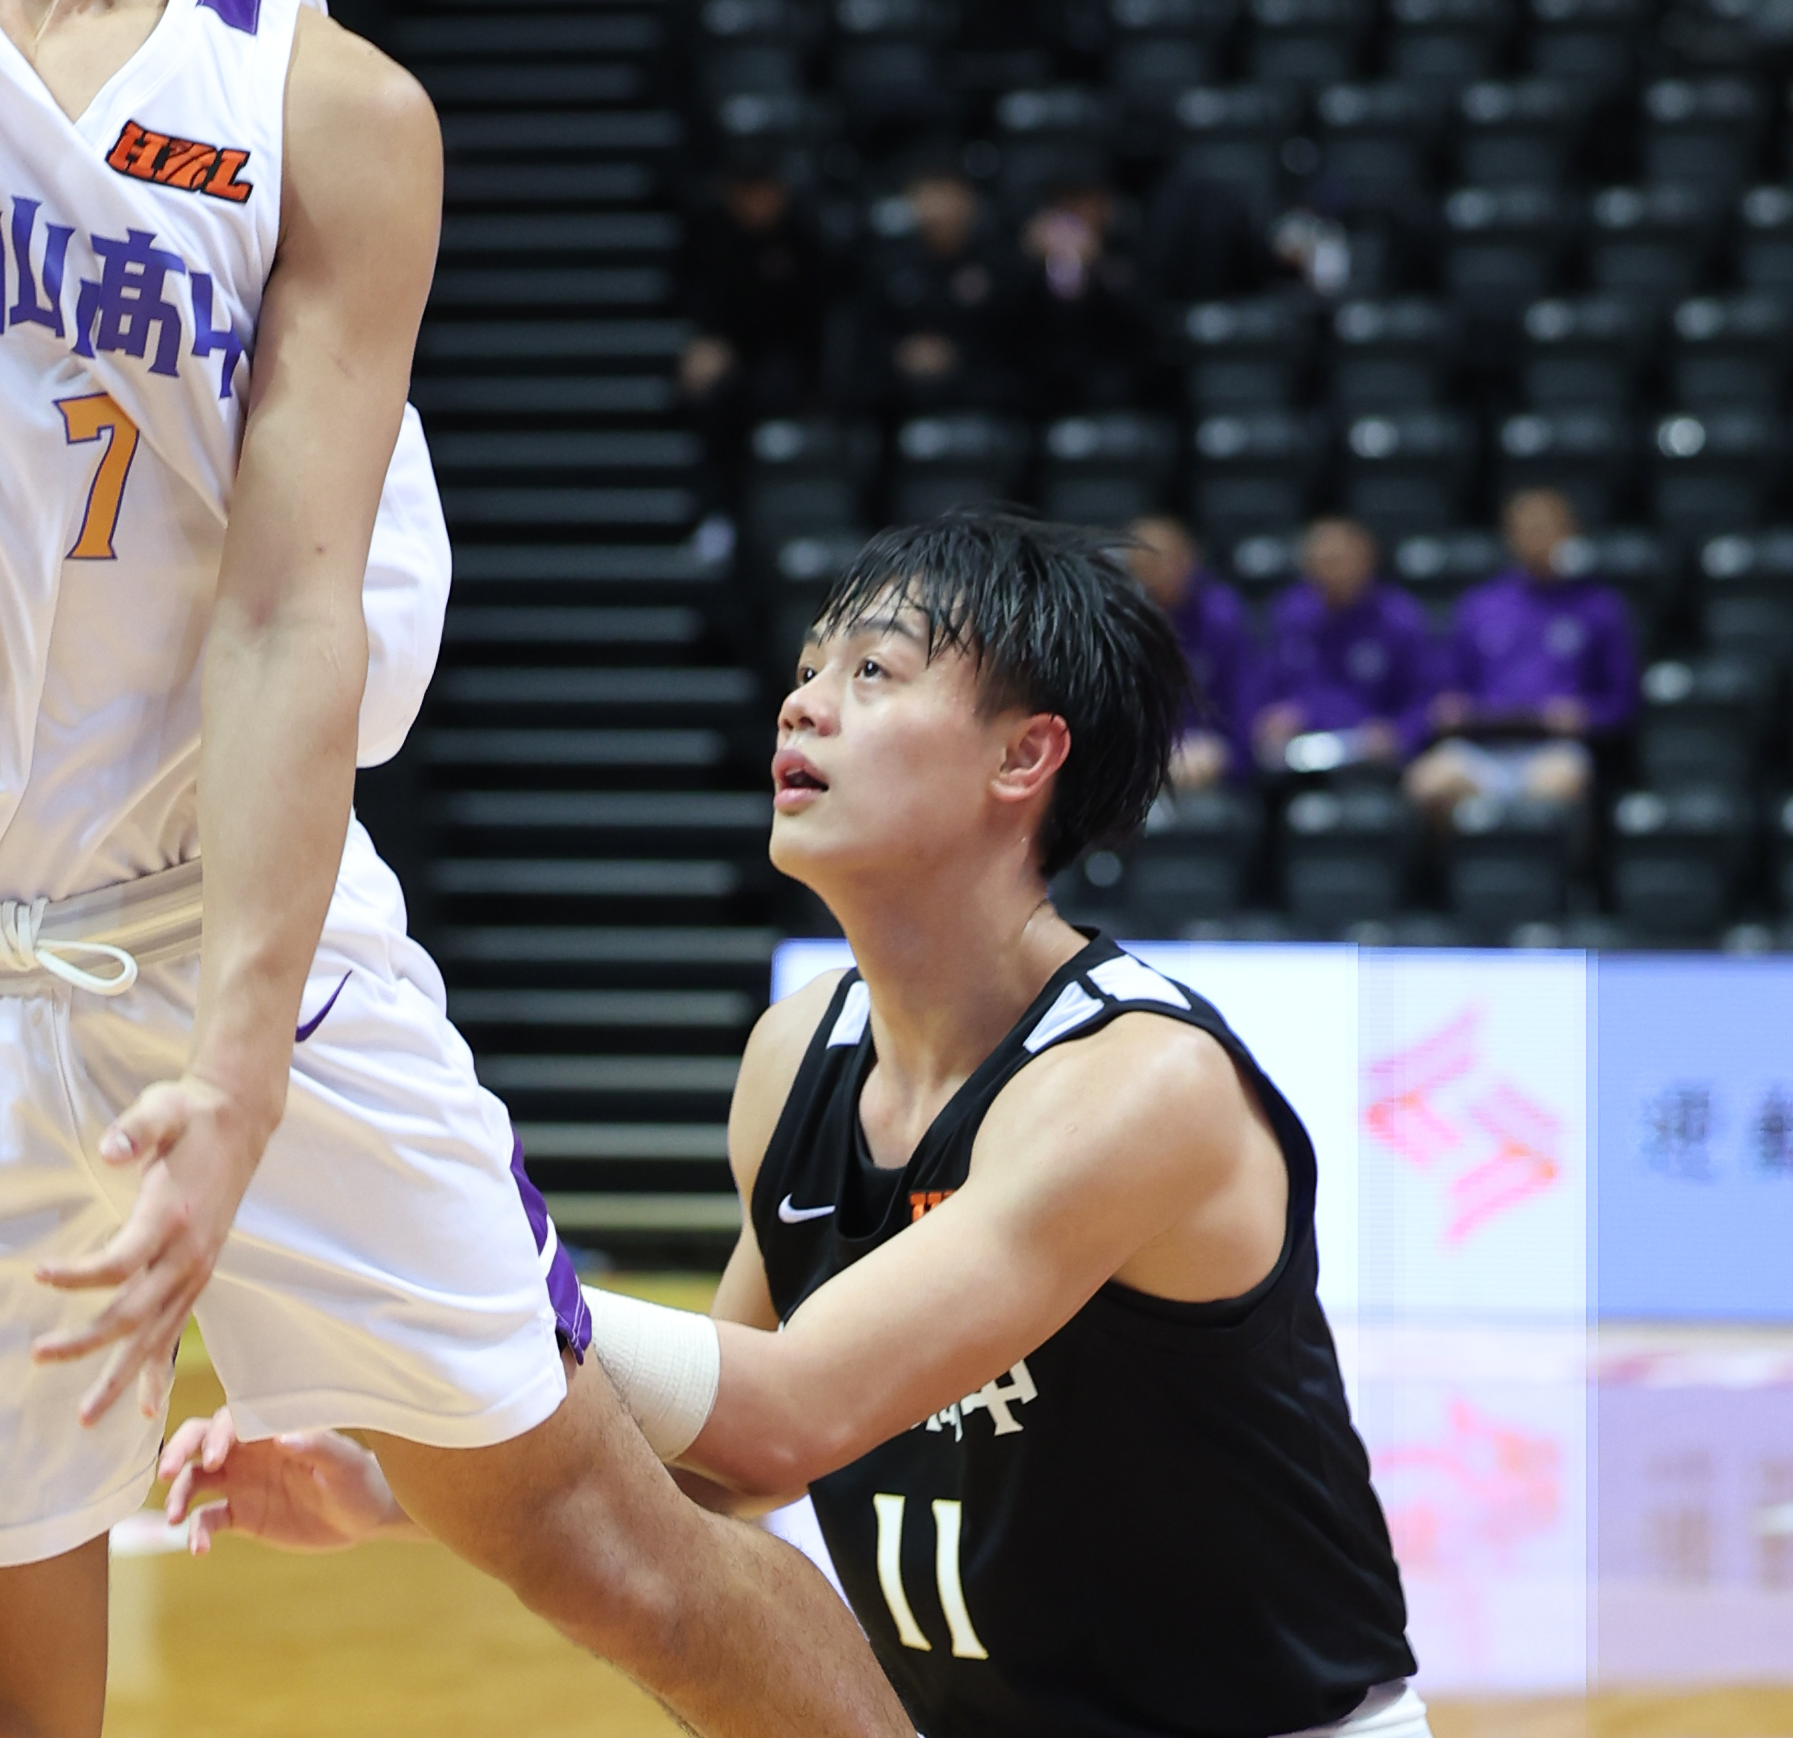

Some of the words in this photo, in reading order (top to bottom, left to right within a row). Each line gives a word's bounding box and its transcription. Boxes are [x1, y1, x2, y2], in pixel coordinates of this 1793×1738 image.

[105, 119, 254, 205] HBL
[51, 391, 141, 560] 7
[872, 1492, 989, 1660] 11
